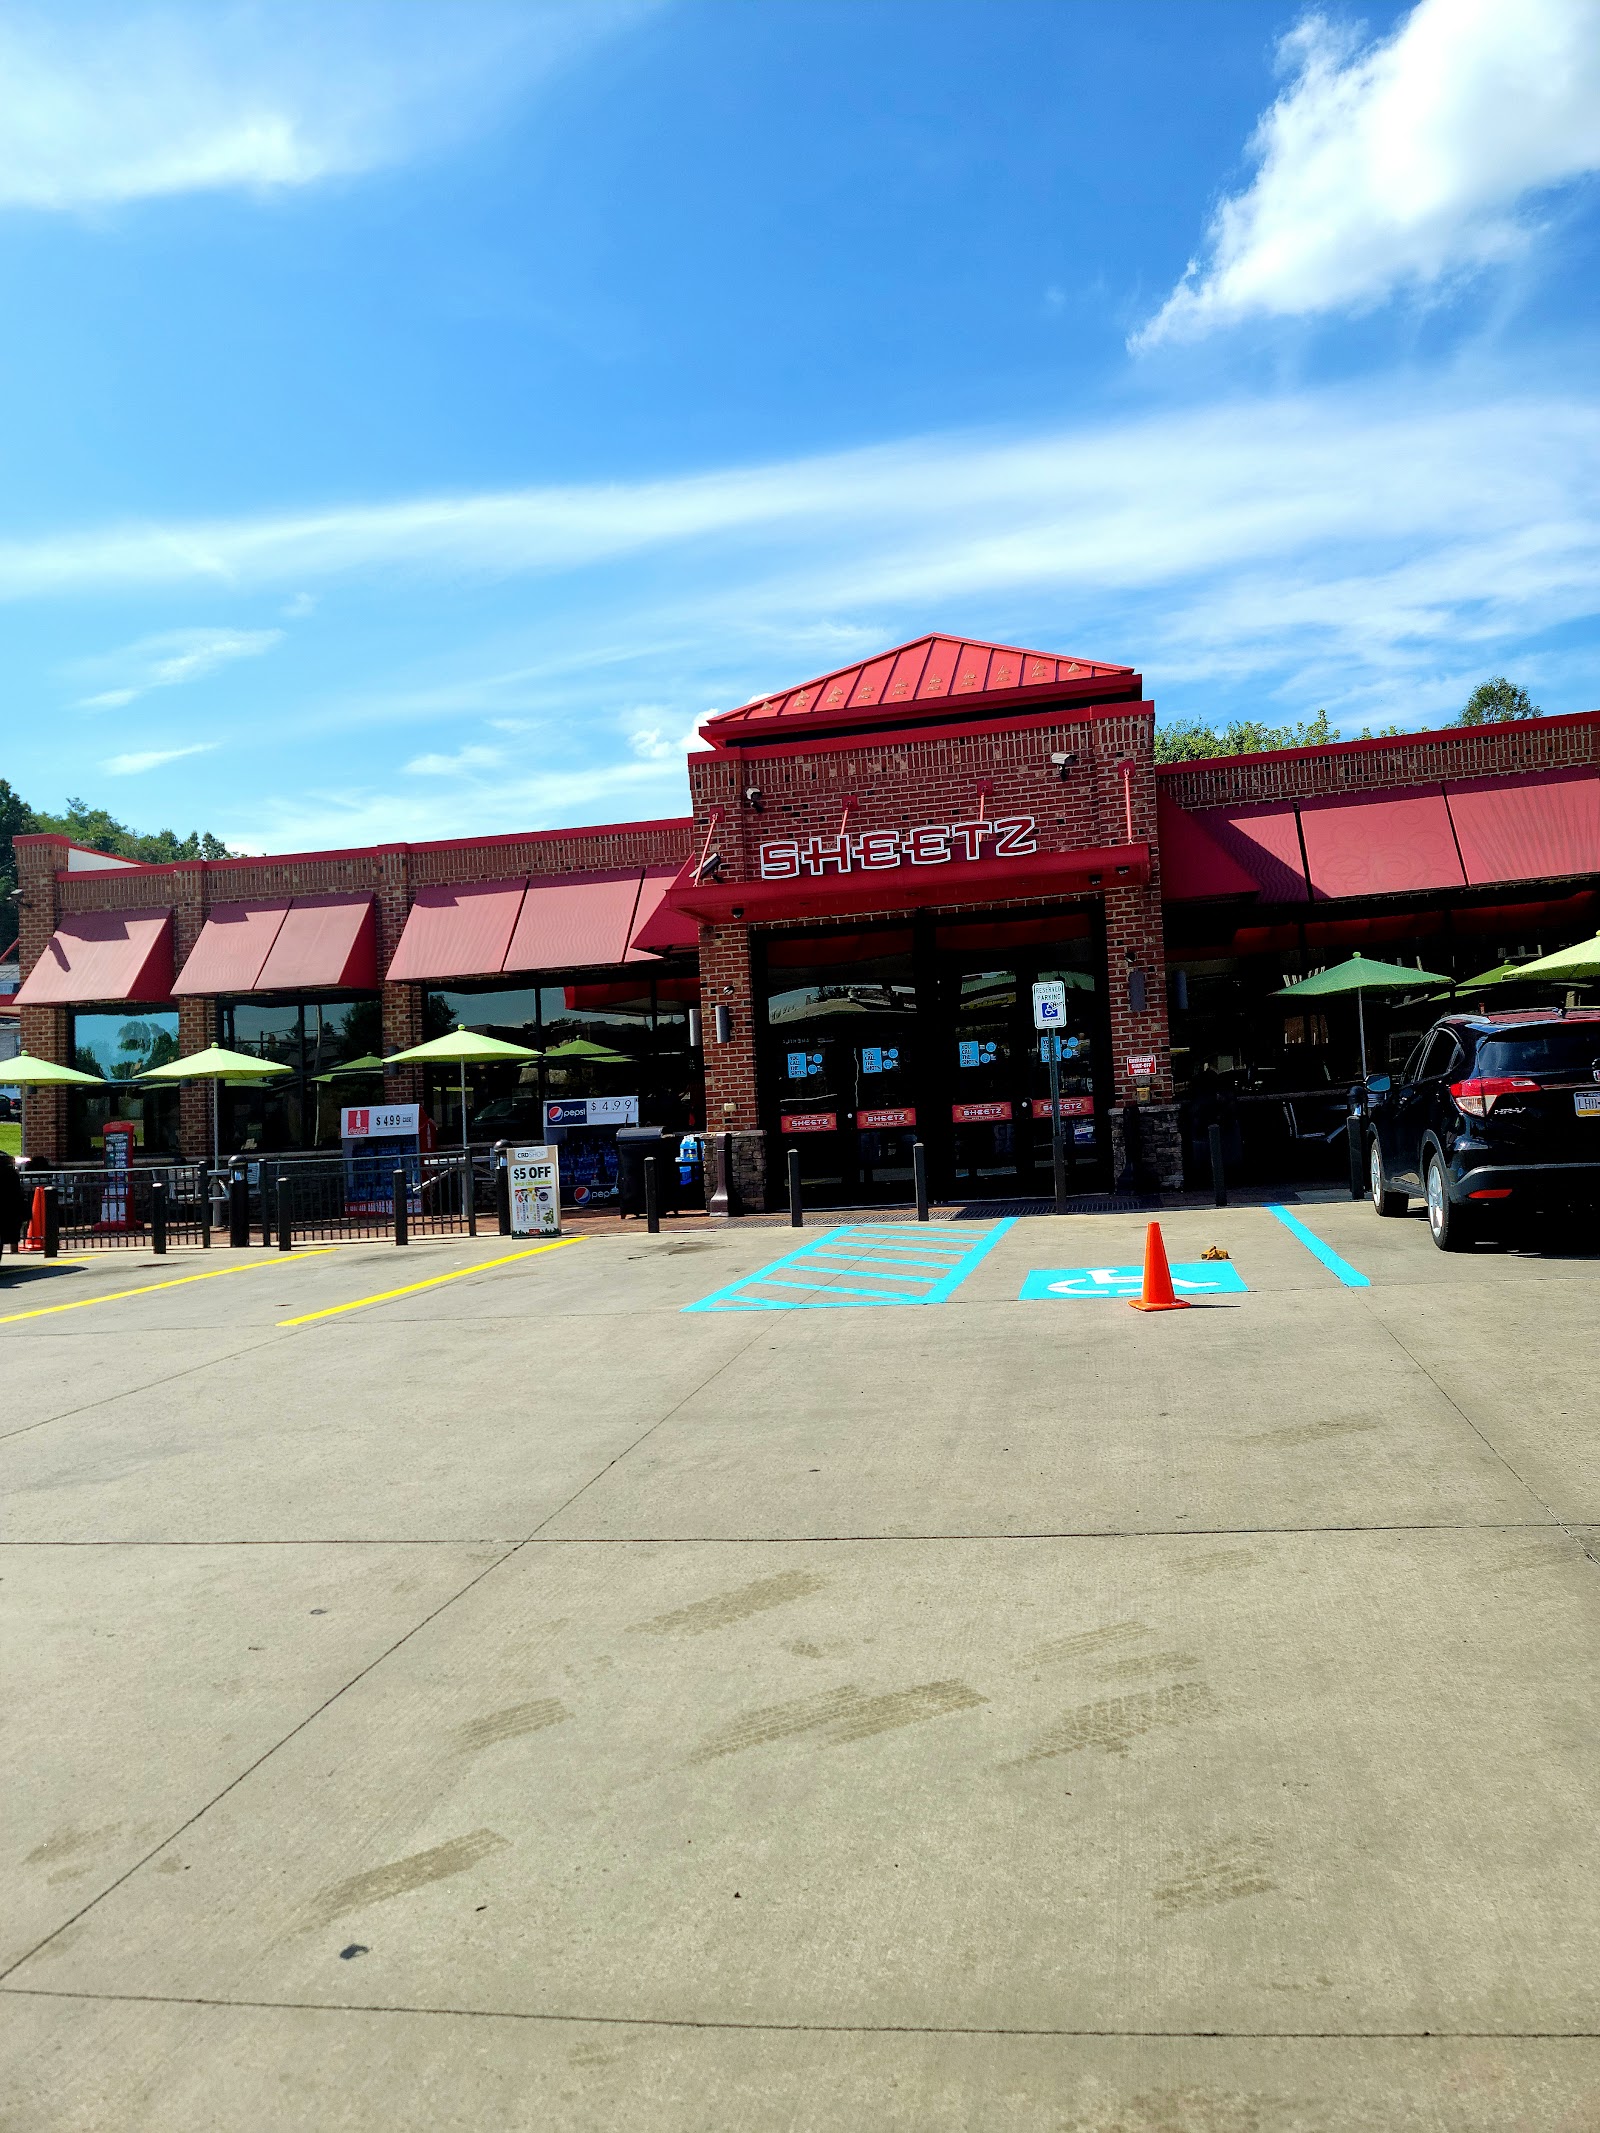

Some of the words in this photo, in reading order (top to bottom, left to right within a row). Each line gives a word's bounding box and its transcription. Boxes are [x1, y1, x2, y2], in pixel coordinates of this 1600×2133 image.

[760, 816, 1037, 880] SHEETZ
[1036, 985, 1062, 994] RESERVED
[1037, 993, 1061, 1001] PARKING
[563, 1107, 586, 1118] pepsi
[963, 1108, 1002, 1116] SHEETZ
[791, 1118, 828, 1127] SHEETZ
[867, 1114, 905, 1123] SHEETZ
[513, 1168, 526, 1180] $5
[529, 1166, 552, 1179] OFF
